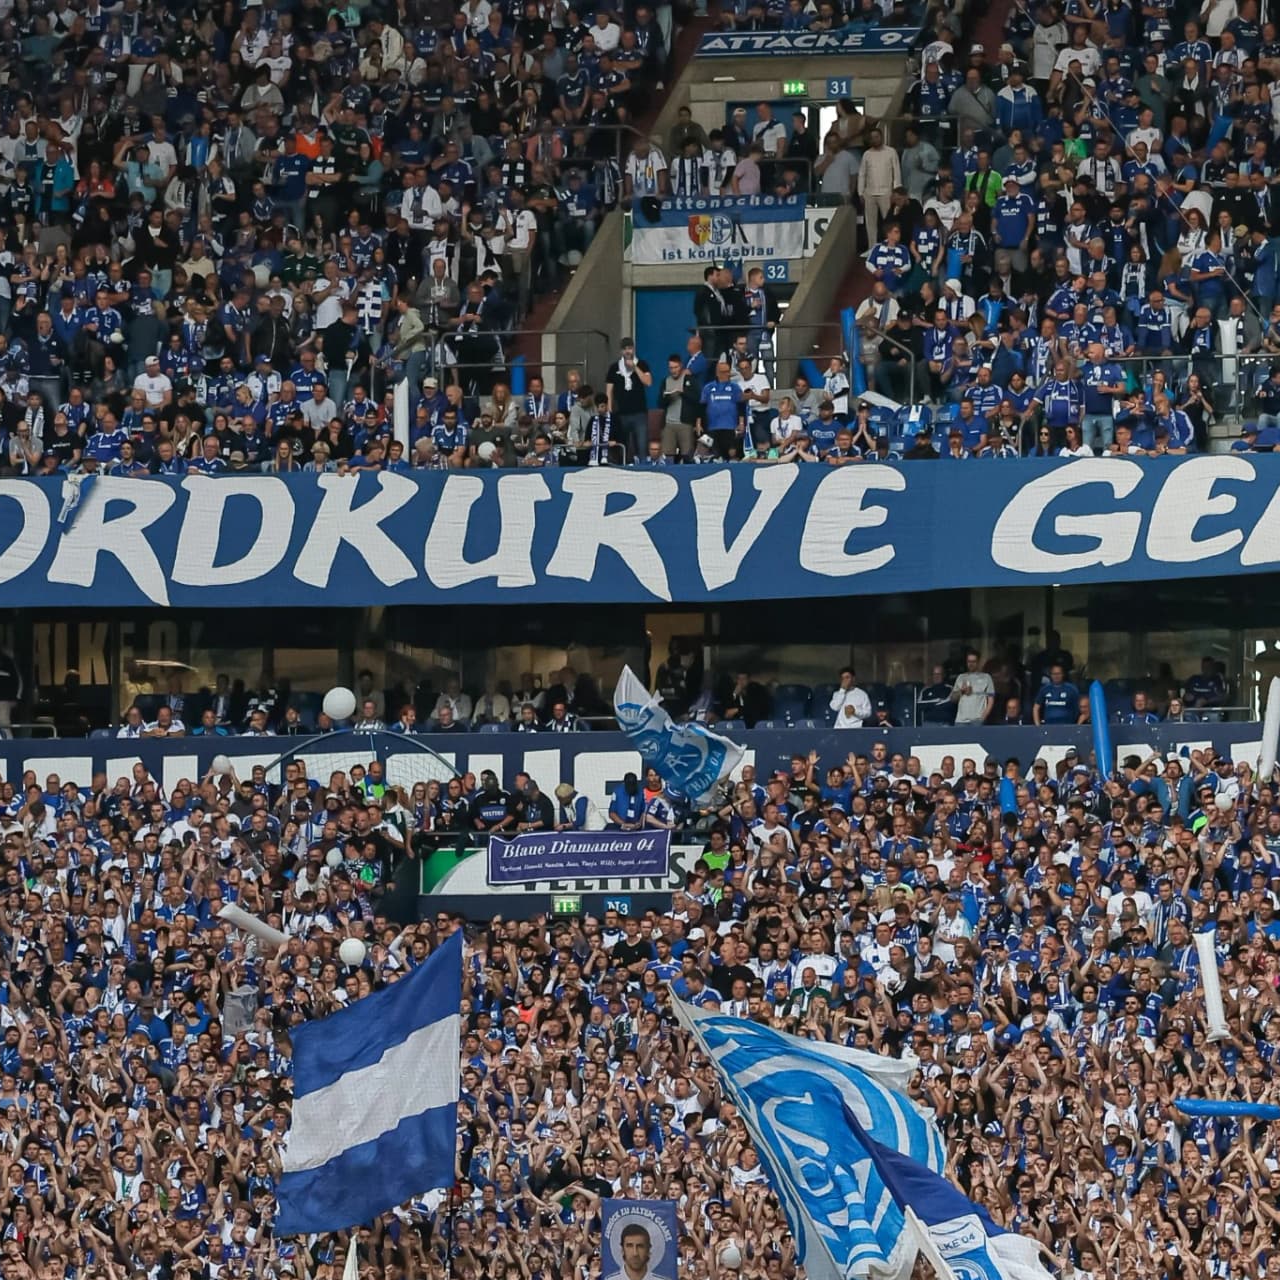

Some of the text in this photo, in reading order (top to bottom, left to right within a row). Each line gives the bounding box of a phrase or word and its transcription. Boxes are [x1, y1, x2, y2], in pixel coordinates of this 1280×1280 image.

[701, 33, 866, 49] ATTACKE
[829, 81, 847, 94] 31
[767, 265, 786, 279] 32
[502, 839, 655, 858] Blaue Diamanten 04
[607, 900, 628, 915] N3
